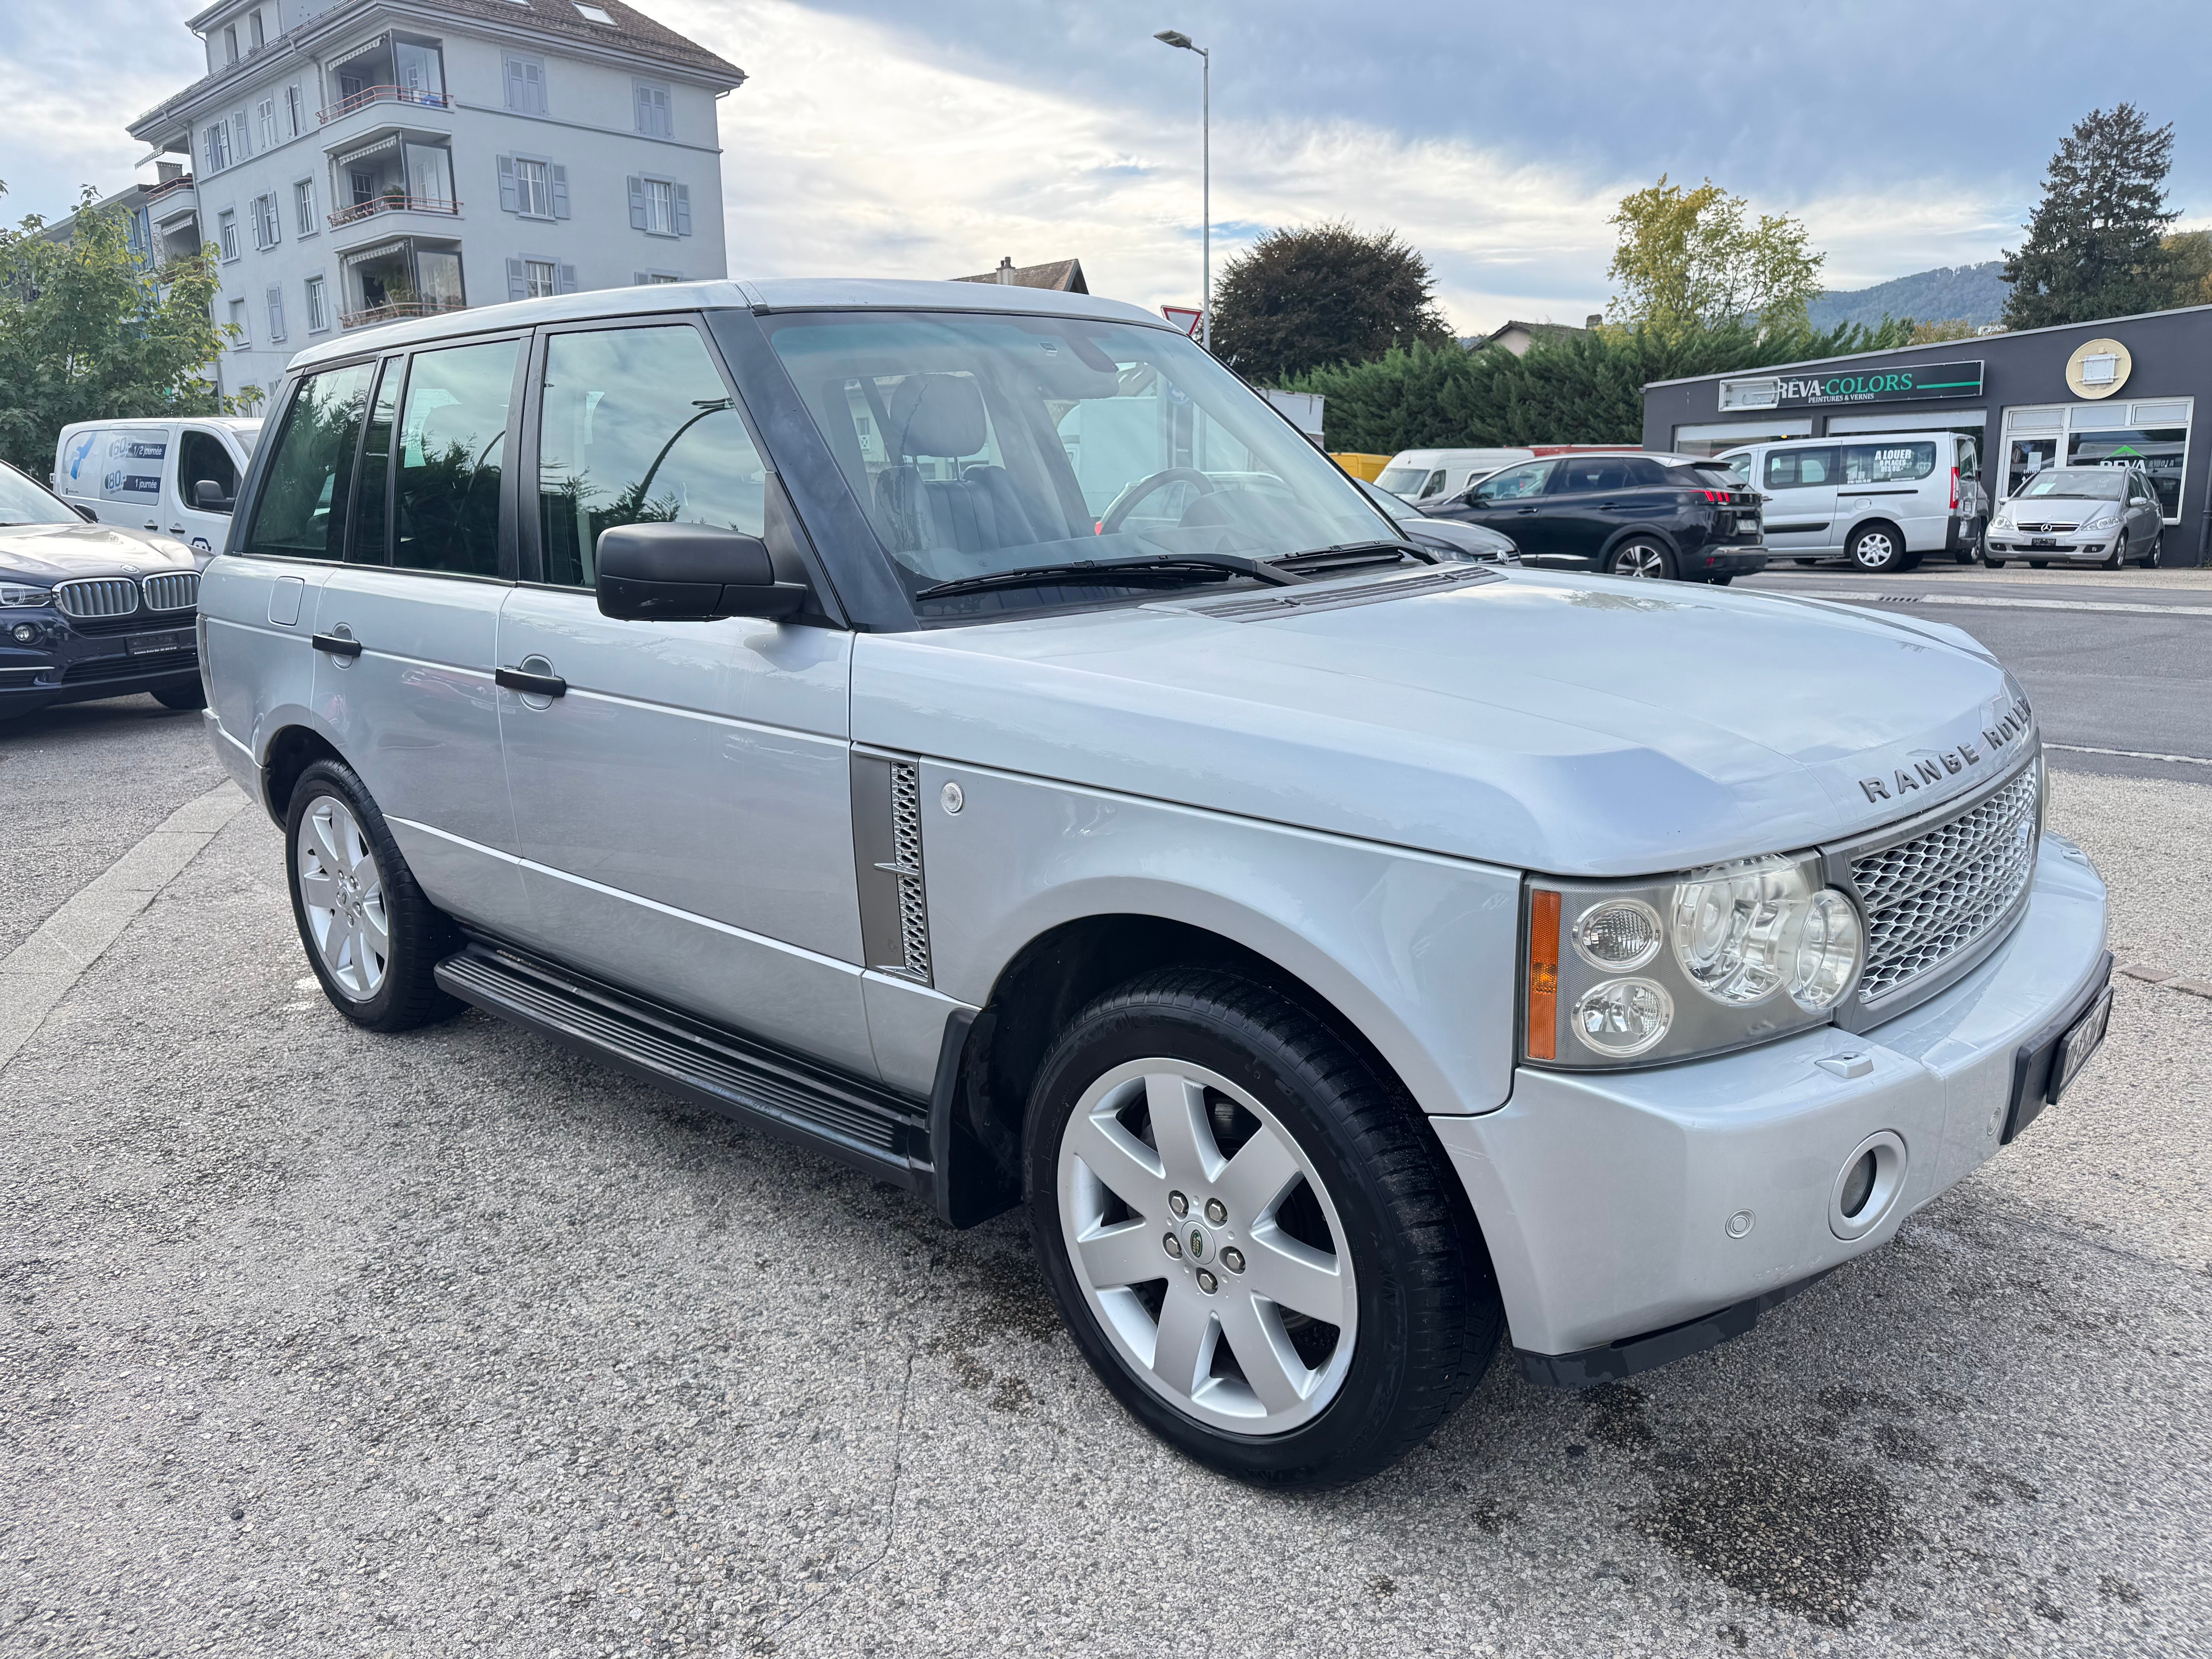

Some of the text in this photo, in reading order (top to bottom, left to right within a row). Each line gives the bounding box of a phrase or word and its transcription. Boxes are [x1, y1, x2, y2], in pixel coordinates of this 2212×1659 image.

[1808, 394, 1843, 403] PEINTURES
[134, 445, 143, 457] 1/2
[143, 446, 162, 456] journée
[1875, 449, 1911, 460] A LOUER
[109, 470, 157, 489] 80.- 1 journée
[1859, 696, 2032, 803] RANGE ROVER
